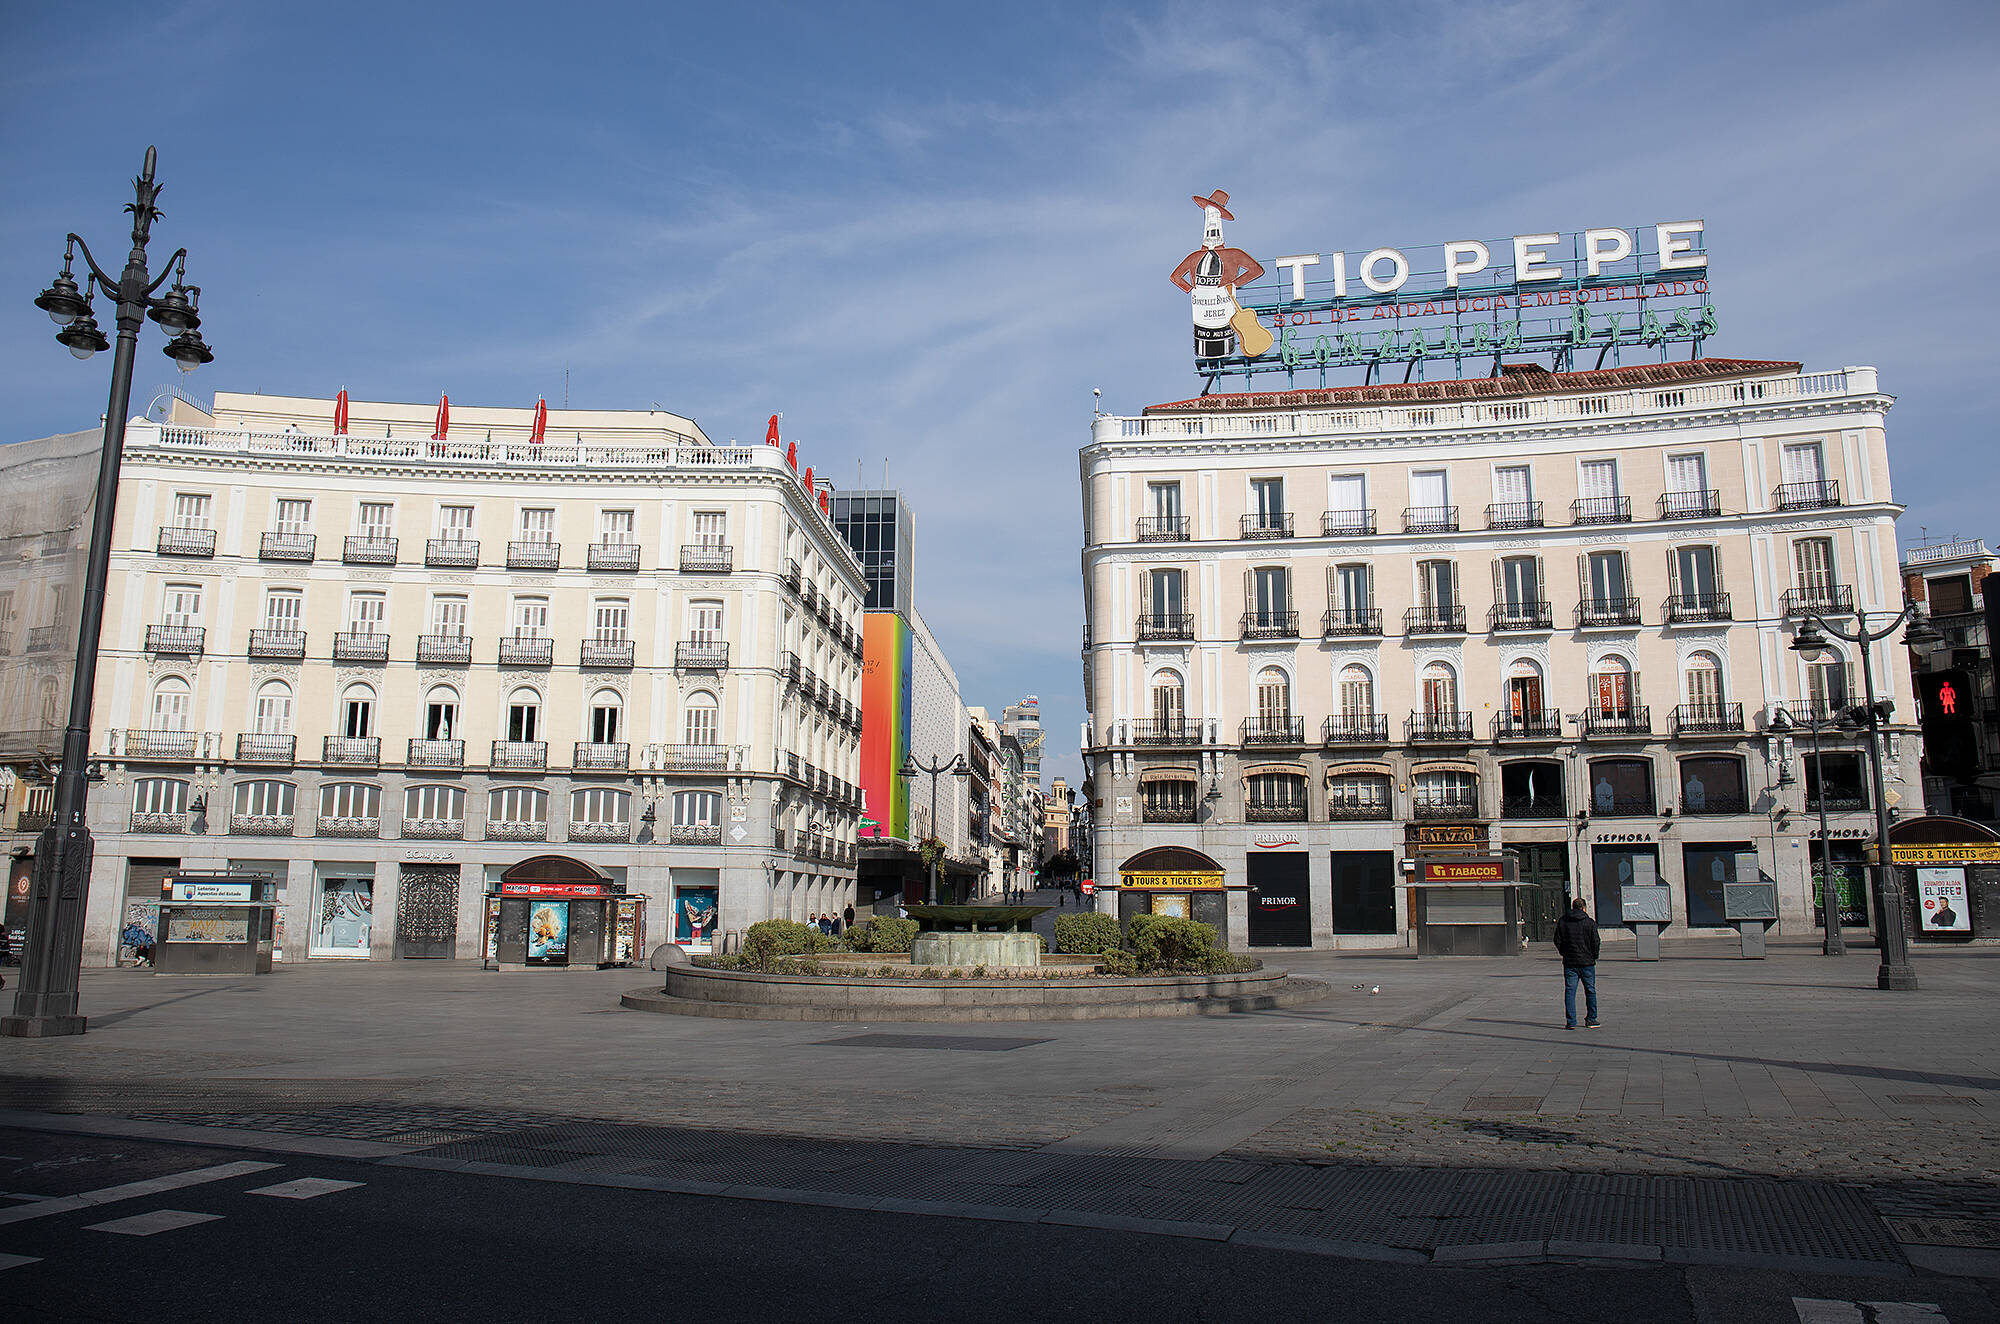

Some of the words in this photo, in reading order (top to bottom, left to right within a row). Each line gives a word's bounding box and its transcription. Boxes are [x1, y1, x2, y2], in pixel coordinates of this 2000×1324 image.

[1275, 247, 1409, 300] TIO
[1444, 219, 1709, 288] PEPE
[1274, 312, 1322, 327] SOL
[1331, 306, 1361, 322] DE
[1372, 295, 1510, 319] ANDALUCIA
[1519, 280, 1709, 308] EMBOTELLADO
[1204, 309, 1226, 318] JEREZ
[1281, 320, 1522, 366] GONZALEZ
[1569, 304, 1719, 345] BYASS
[1254, 833, 1298, 842] PRIMOR
[1422, 832, 1472, 842] PALAZZO
[1597, 833, 1651, 843] SEPHORA
[1894, 850, 1924, 860] TOURS
[1937, 850, 1977, 859] TICKETS
[1450, 867, 1497, 876] TABACOS
[1136, 877, 1160, 885] TOURS
[1162, 877, 1168, 885] &
[1170, 877, 1202, 885] TICKETS
[1924, 887, 1934, 896] EL
[1936, 886, 1955, 896] JEFE
[1262, 897, 1296, 905] PRIMOR
